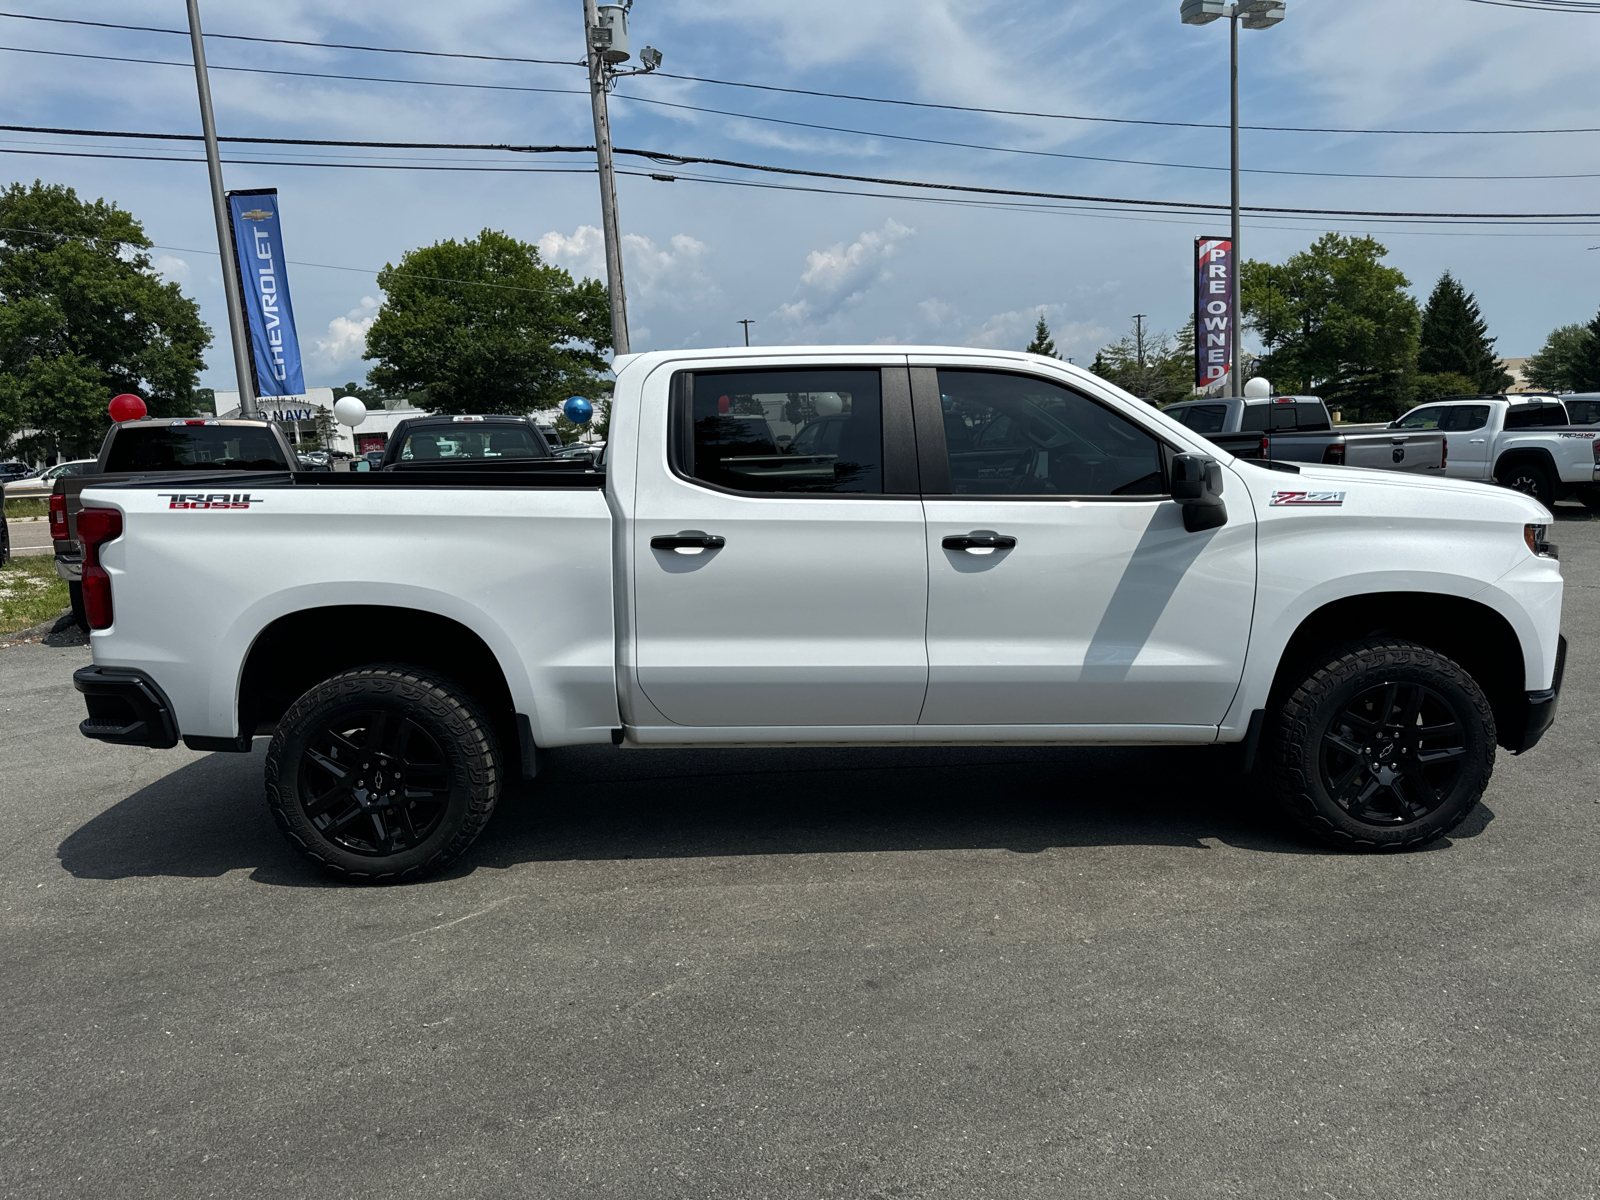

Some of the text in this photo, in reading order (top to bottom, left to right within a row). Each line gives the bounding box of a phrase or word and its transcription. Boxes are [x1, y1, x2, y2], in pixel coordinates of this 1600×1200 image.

[253, 226, 287, 382] CHEVROLET
[1203, 249, 1229, 379] PRE OWNED
[273, 408, 312, 422] NAVY
[157, 493, 264, 503] TRAIL
[169, 502, 250, 510] BOSS
[1269, 490, 1347, 507] Z71
[402, 702, 467, 788] GOODYEAR
[282, 785, 342, 863] WRANGLER
[1339, 818, 1433, 843] WRANGLER
